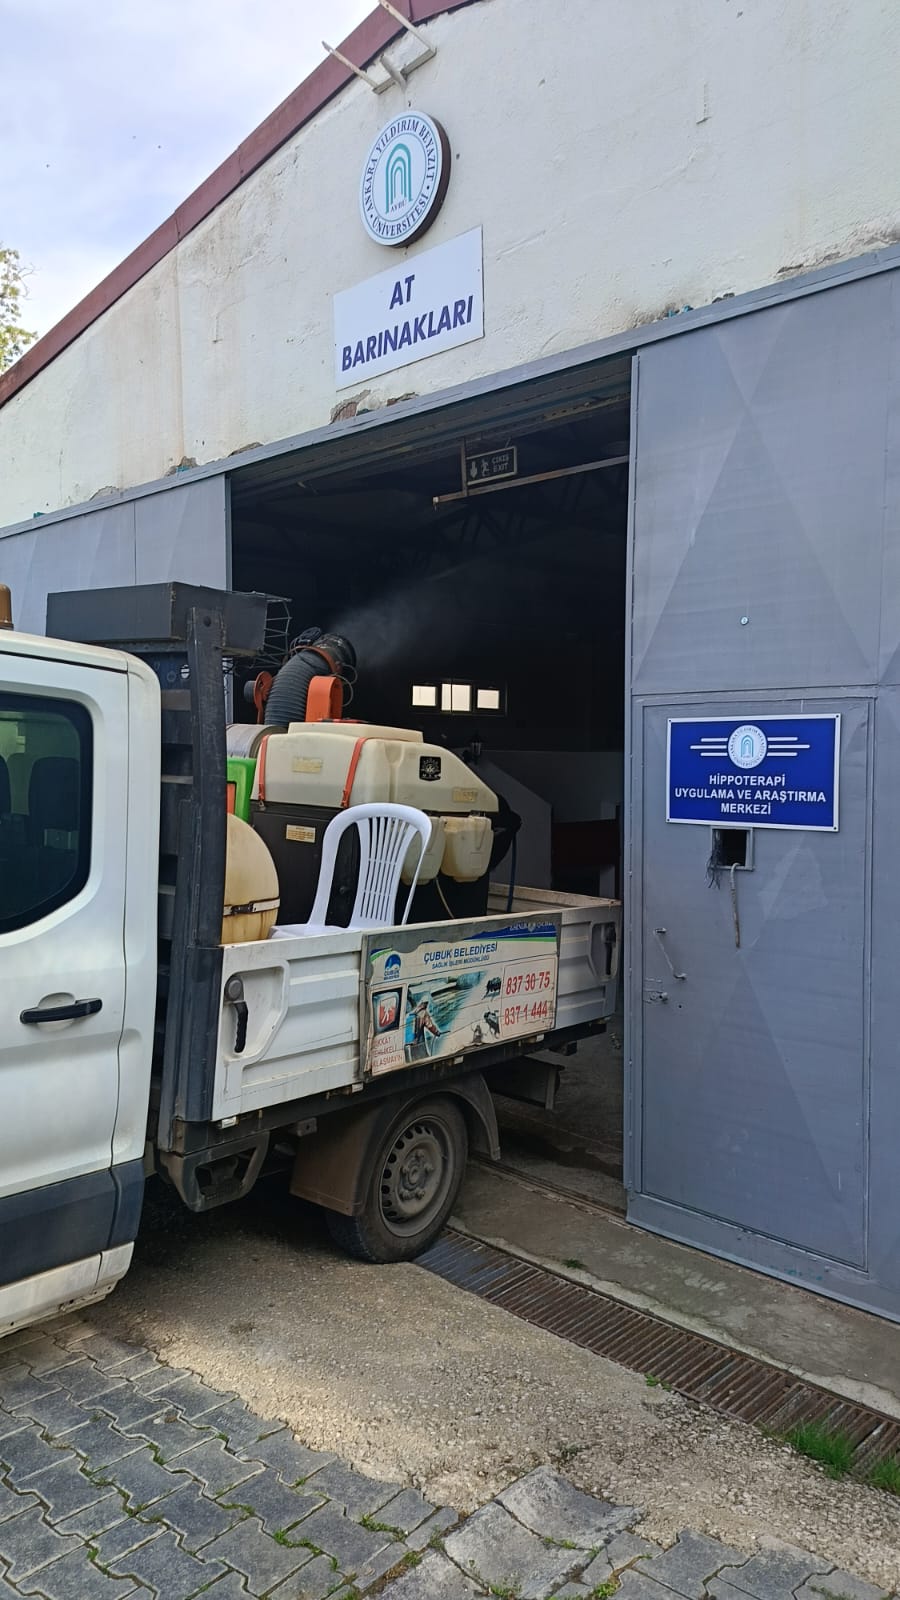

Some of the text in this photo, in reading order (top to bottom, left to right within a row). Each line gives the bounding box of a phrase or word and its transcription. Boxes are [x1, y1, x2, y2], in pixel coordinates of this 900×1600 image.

[364, 119, 436, 213] ANKARA YILDIRIM BEYAZIT
[389, 274, 415, 310] AT
[341, 295, 474, 372] BARINAKLARI
[493, 463, 508, 472] EXIT
[709, 773, 786, 786] HİPPOTERAPİ
[675, 788, 827, 803] UYGULAMA VE ARAŞTIRMA
[720, 802, 772, 815] MERKEZİ
[424, 941, 498, 965] ÇUBUK BELEDİYESİ
[506, 971, 550, 995] 837 30 75
[504, 1005, 521, 1026] 837
[531, 1000, 548, 1019] 444
